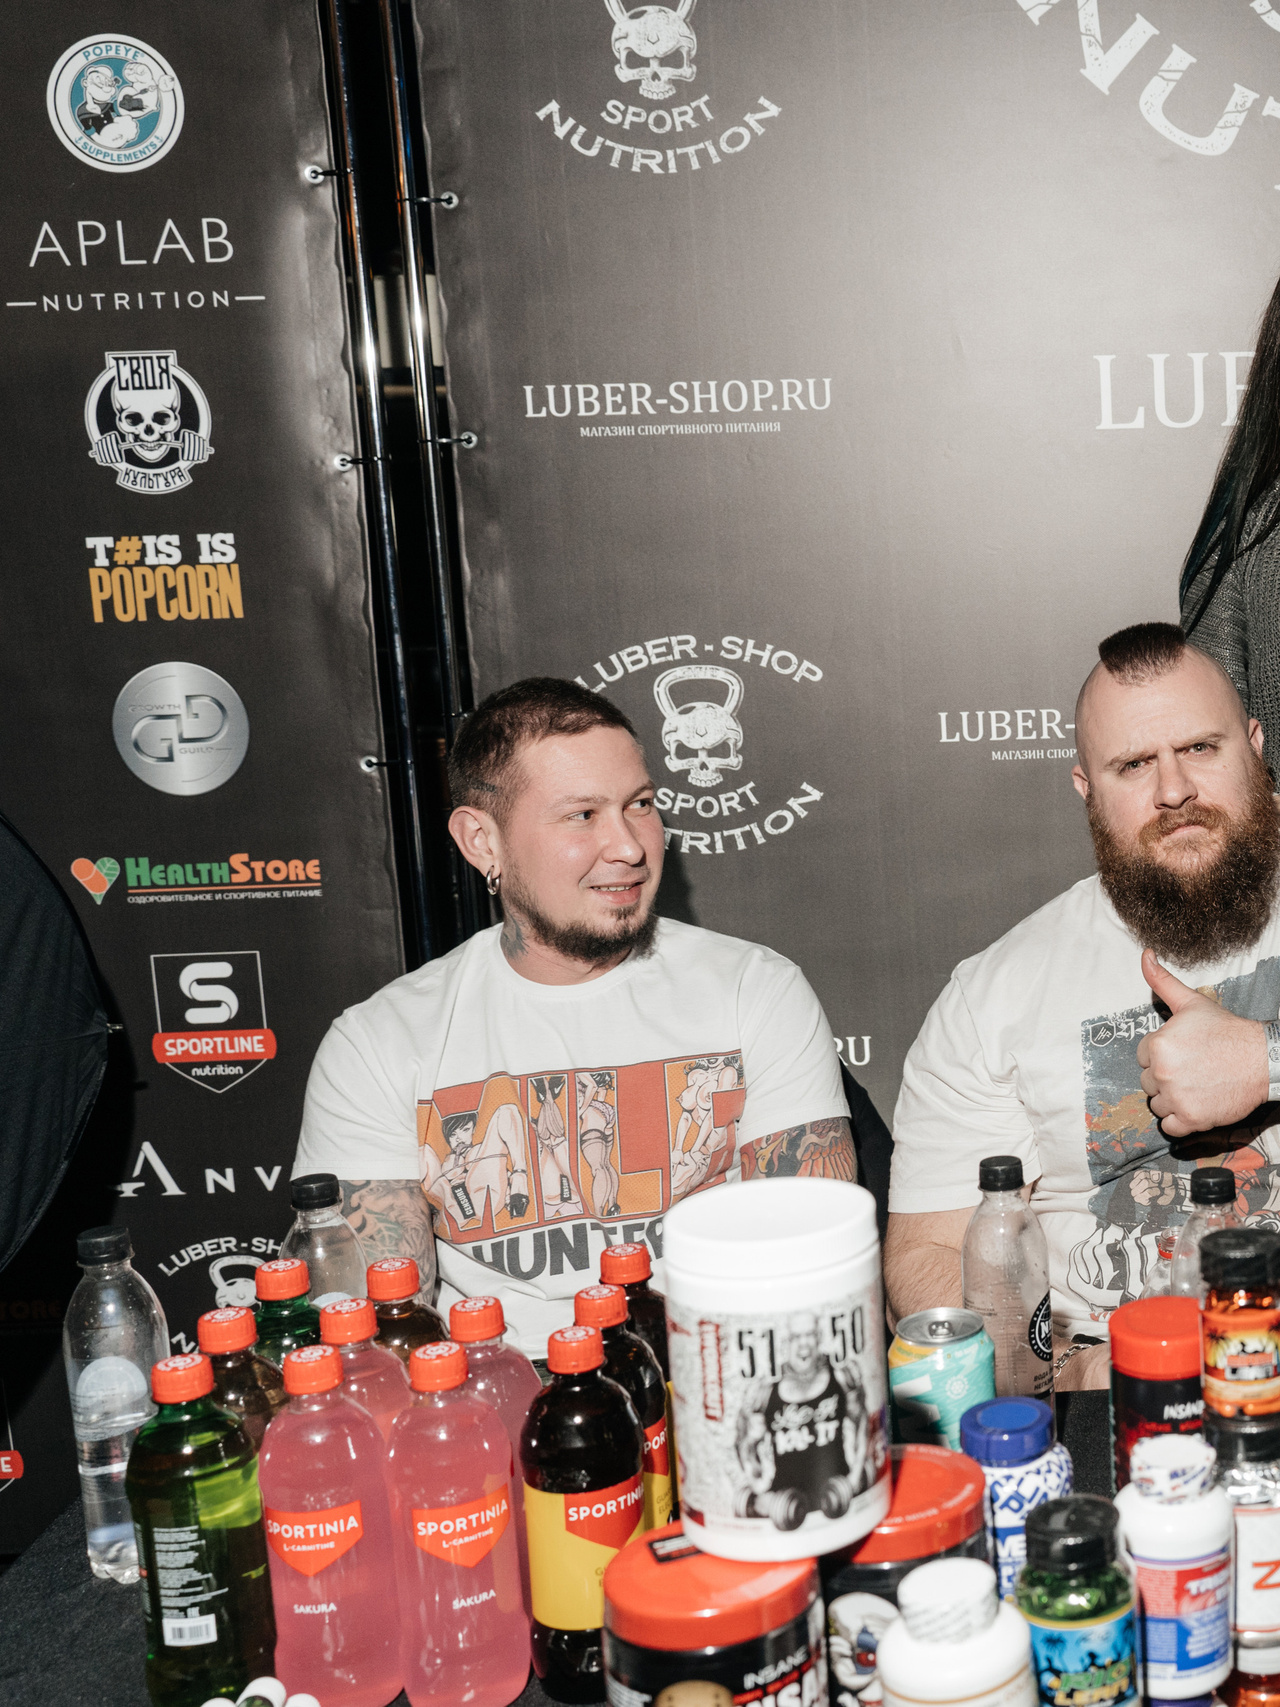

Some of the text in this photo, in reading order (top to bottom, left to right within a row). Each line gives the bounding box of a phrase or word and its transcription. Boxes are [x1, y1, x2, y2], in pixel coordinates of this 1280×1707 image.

[600, 94, 715, 134] SPORT
[535, 95, 783, 174] NUTRITION
[81, 140, 158, 162] SUPPLEMENTS
[29, 217, 234, 268] APLAB
[42, 290, 229, 312] NUTRITION
[113, 355, 171, 390] СВОЯ
[523, 377, 833, 418] LUBER-SHOP.RU
[580, 421, 781, 438] МАГАЗИН СПОРТИВНОГО ПИТАНИЯ
[122, 466, 187, 490] КУЛЬТУРА
[197, 532, 237, 563] IS
[88, 563, 244, 623] POPCORN
[720, 636, 823, 683] SHOP
[991, 748, 1044, 762] МАГАЗИН
[653, 781, 760, 818] SPORT
[223, 890, 281, 900] СПОРТИВНОЕ
[282, 888, 322, 898] ПИТАНИЕ
[164, 1034, 265, 1057] SPORTLINE
[191, 1064, 243, 1077] nutrition
[454, 1187, 474, 1215] CENSURE
[157, 1237, 240, 1278] LUBER
[267, 1515, 358, 1540] SPORTINIA
[416, 1498, 509, 1537] SPORTINIA
[282, 1541, 335, 1552] L-CARNITINE
[442, 1526, 494, 1549] L-CARNITINE
[293, 1602, 337, 1615] SAKURA
[452, 1588, 497, 1610] SAKURA
